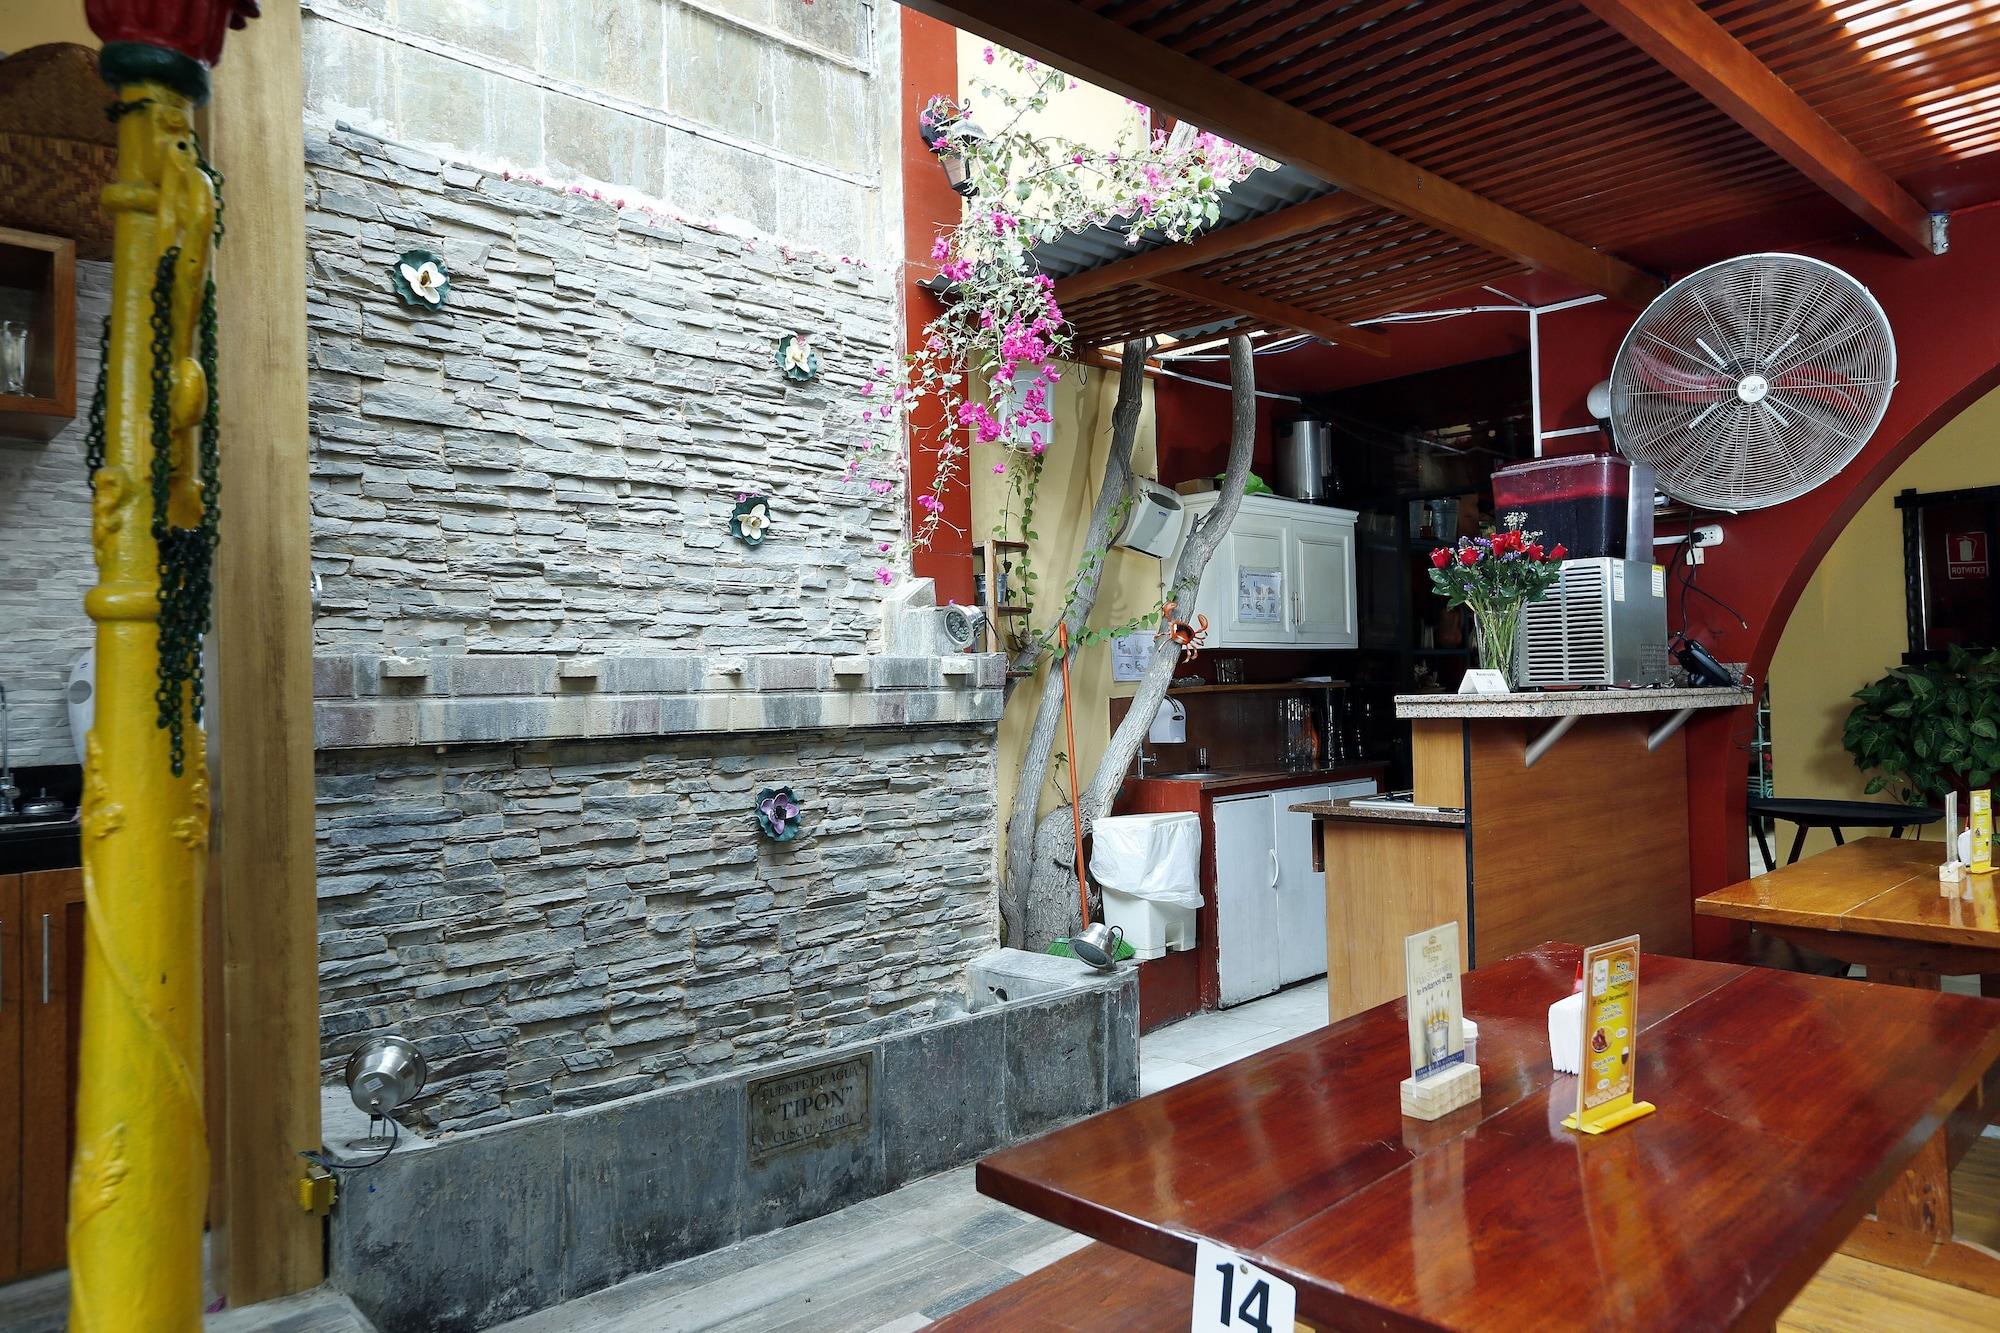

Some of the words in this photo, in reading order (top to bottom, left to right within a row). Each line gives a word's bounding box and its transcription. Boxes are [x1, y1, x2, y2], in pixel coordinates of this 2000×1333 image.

[761, 1080, 809, 1100] FUENTE
[811, 1074, 828, 1089] DE
[828, 1065, 859, 1083] AGUA
[773, 1123, 813, 1144] CUSCO
[821, 1112, 849, 1130] PERU
[1216, 1262, 1272, 1333] 14
